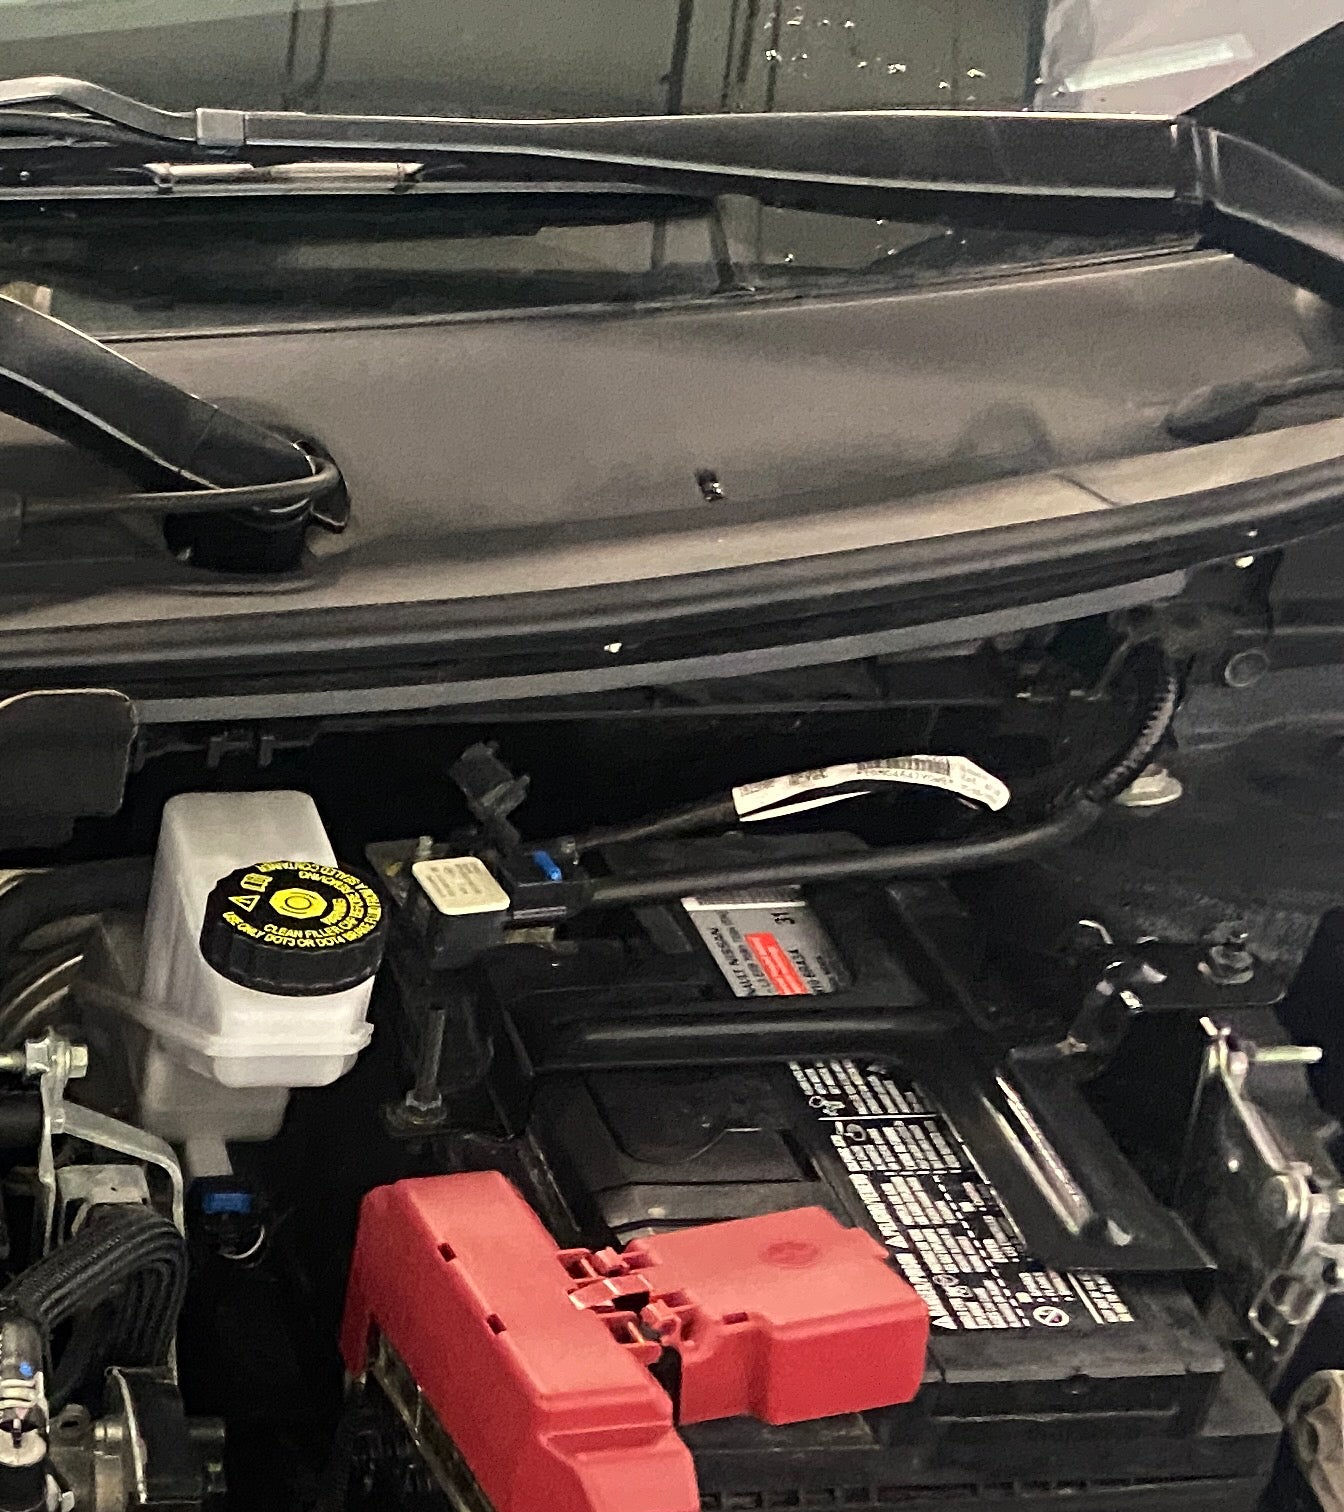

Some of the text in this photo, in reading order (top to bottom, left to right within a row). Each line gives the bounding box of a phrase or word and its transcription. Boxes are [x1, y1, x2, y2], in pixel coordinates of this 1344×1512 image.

[298, 870, 354, 895] REMOVING
[319, 865, 361, 887] SEALED
[237, 923, 266, 938] ONLY
[263, 923, 302, 938] CLEAN
[304, 925, 343, 939] FILLER
[264, 934, 295, 947] DOT3
[297, 938, 316, 947] OR
[316, 935, 346, 947] DOT4
